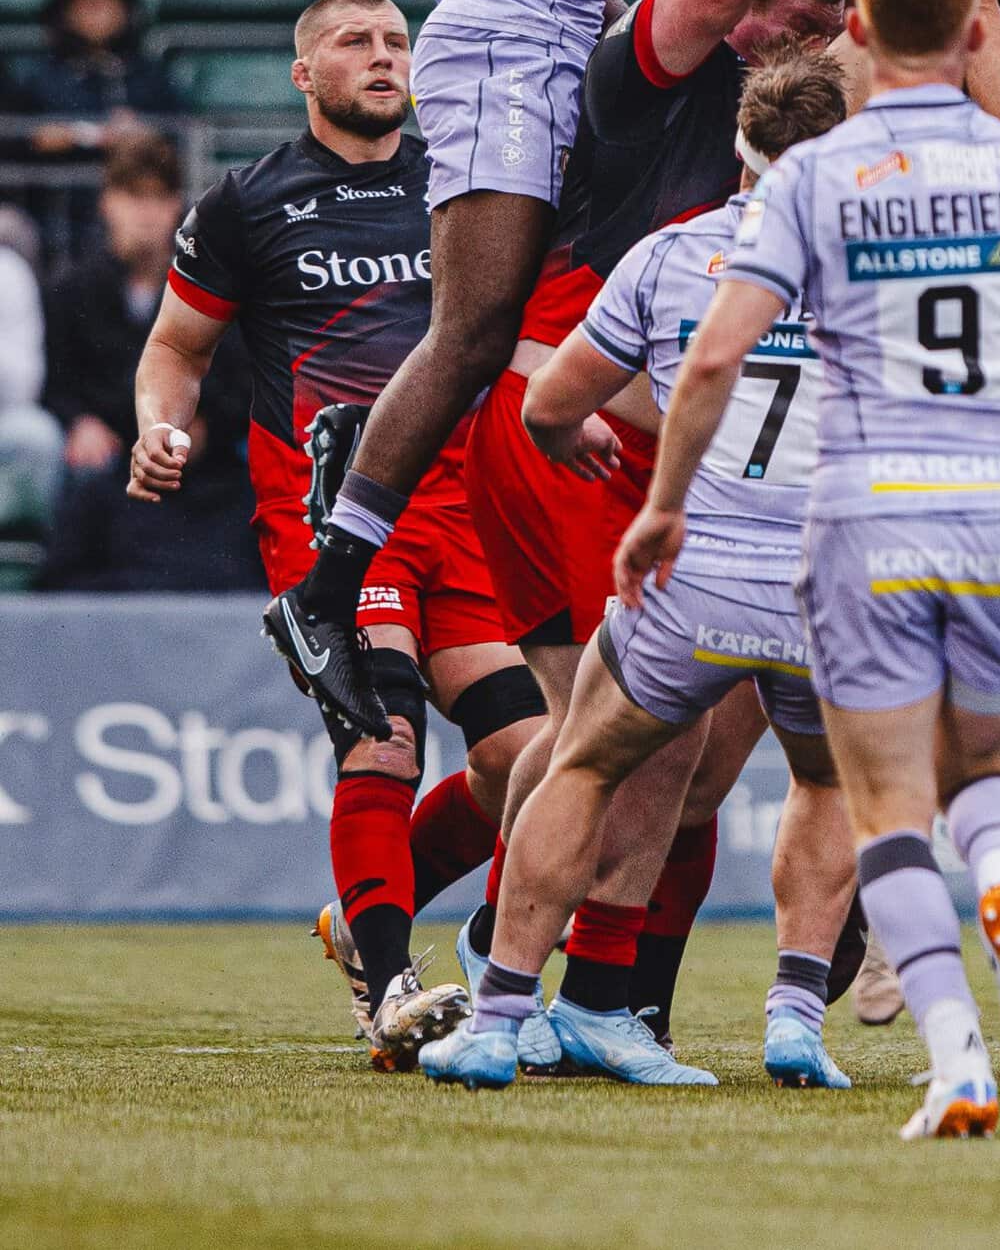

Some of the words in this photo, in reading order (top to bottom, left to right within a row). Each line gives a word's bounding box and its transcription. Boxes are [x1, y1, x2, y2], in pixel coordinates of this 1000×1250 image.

[509, 70, 525, 146] ARIAT
[297, 248, 432, 291] Stone
[853, 245, 982, 274] ALLSTONE
[917, 284, 988, 395] 9
[741, 361, 802, 479] 7
